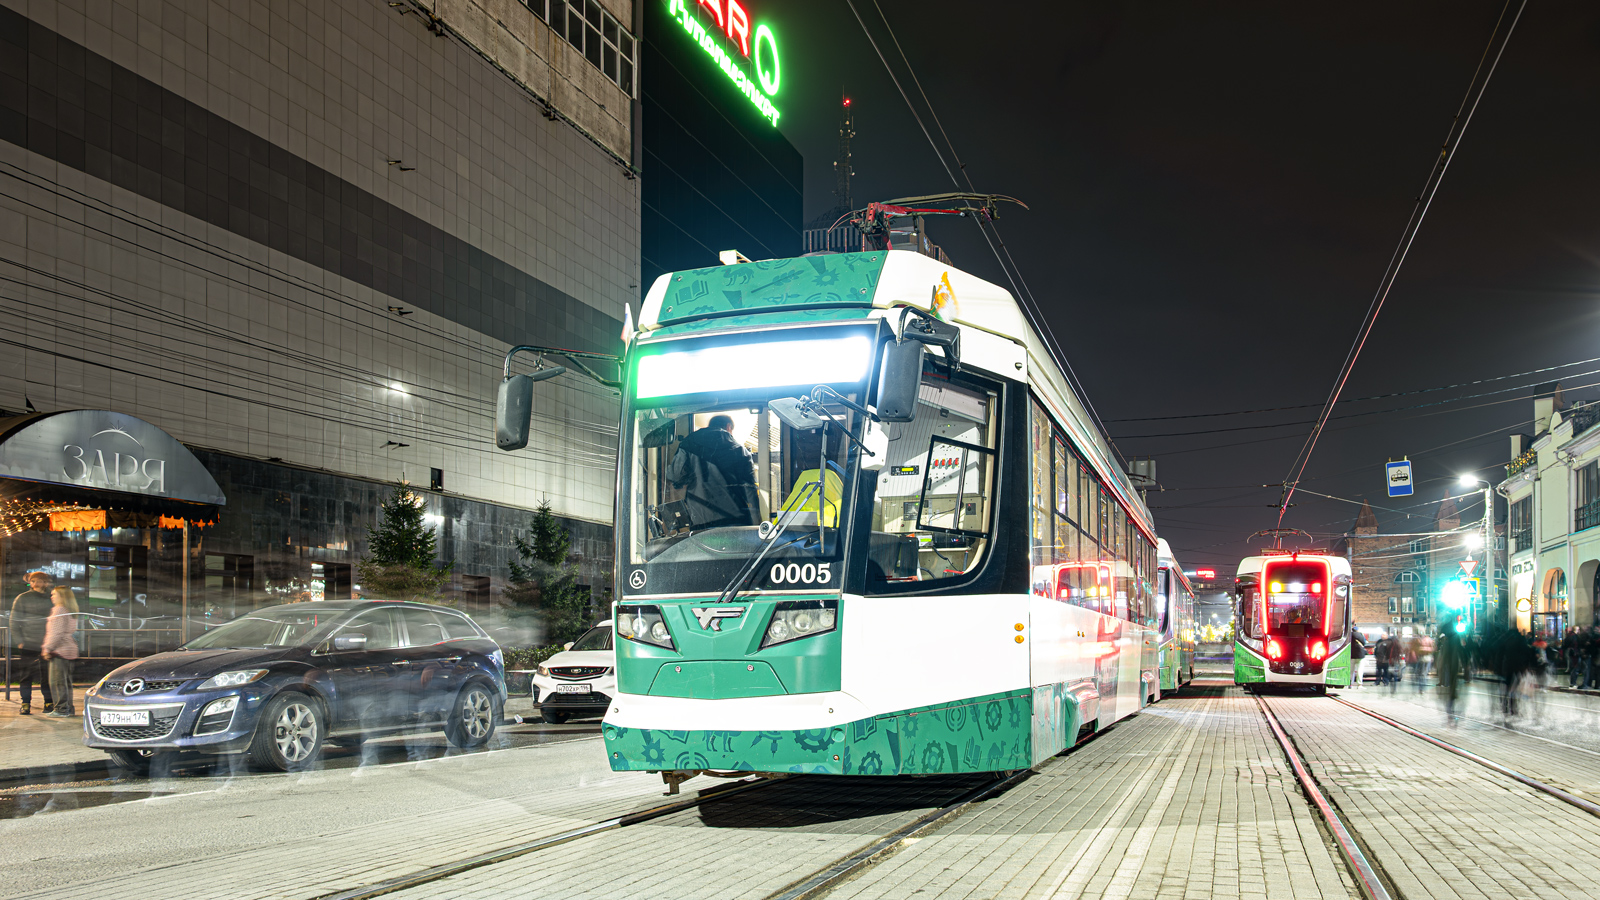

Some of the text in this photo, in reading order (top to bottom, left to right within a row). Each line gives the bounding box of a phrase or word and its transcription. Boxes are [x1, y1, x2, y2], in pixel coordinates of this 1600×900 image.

[63, 444, 166, 493] ЗАРЯ
[770, 563, 832, 584] 0005
[133, 712, 148, 721] 174
